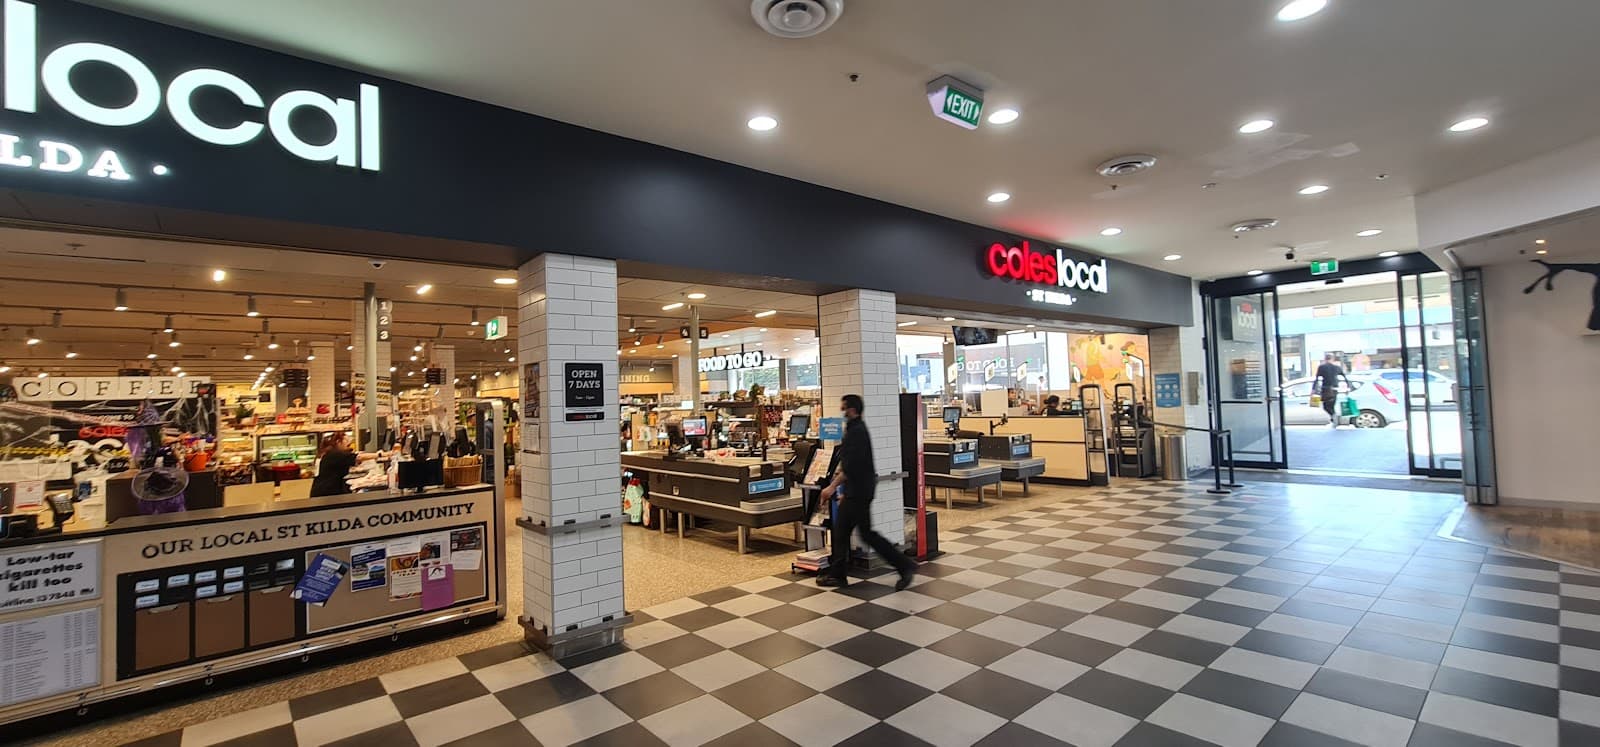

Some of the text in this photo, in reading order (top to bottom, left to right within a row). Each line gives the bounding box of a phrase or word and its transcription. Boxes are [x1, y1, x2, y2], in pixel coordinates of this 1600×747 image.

[4, 0, 381, 171] local
[951, 94, 976, 120] EXIT
[988, 240, 1108, 294] coles local
[380, 316, 389, 325] 2
[380, 331, 389, 340] 3
[698, 351, 761, 372] FOOD TO GO
[571, 370, 598, 378] OPEN
[568, 380, 601, 389] 7 DAYS
[141, 502, 475, 560] OUR LOCAL ST KILDA COMMUNITY
[7, 551, 75, 566] Low-tar
[8, 577, 72, 592] kill too
